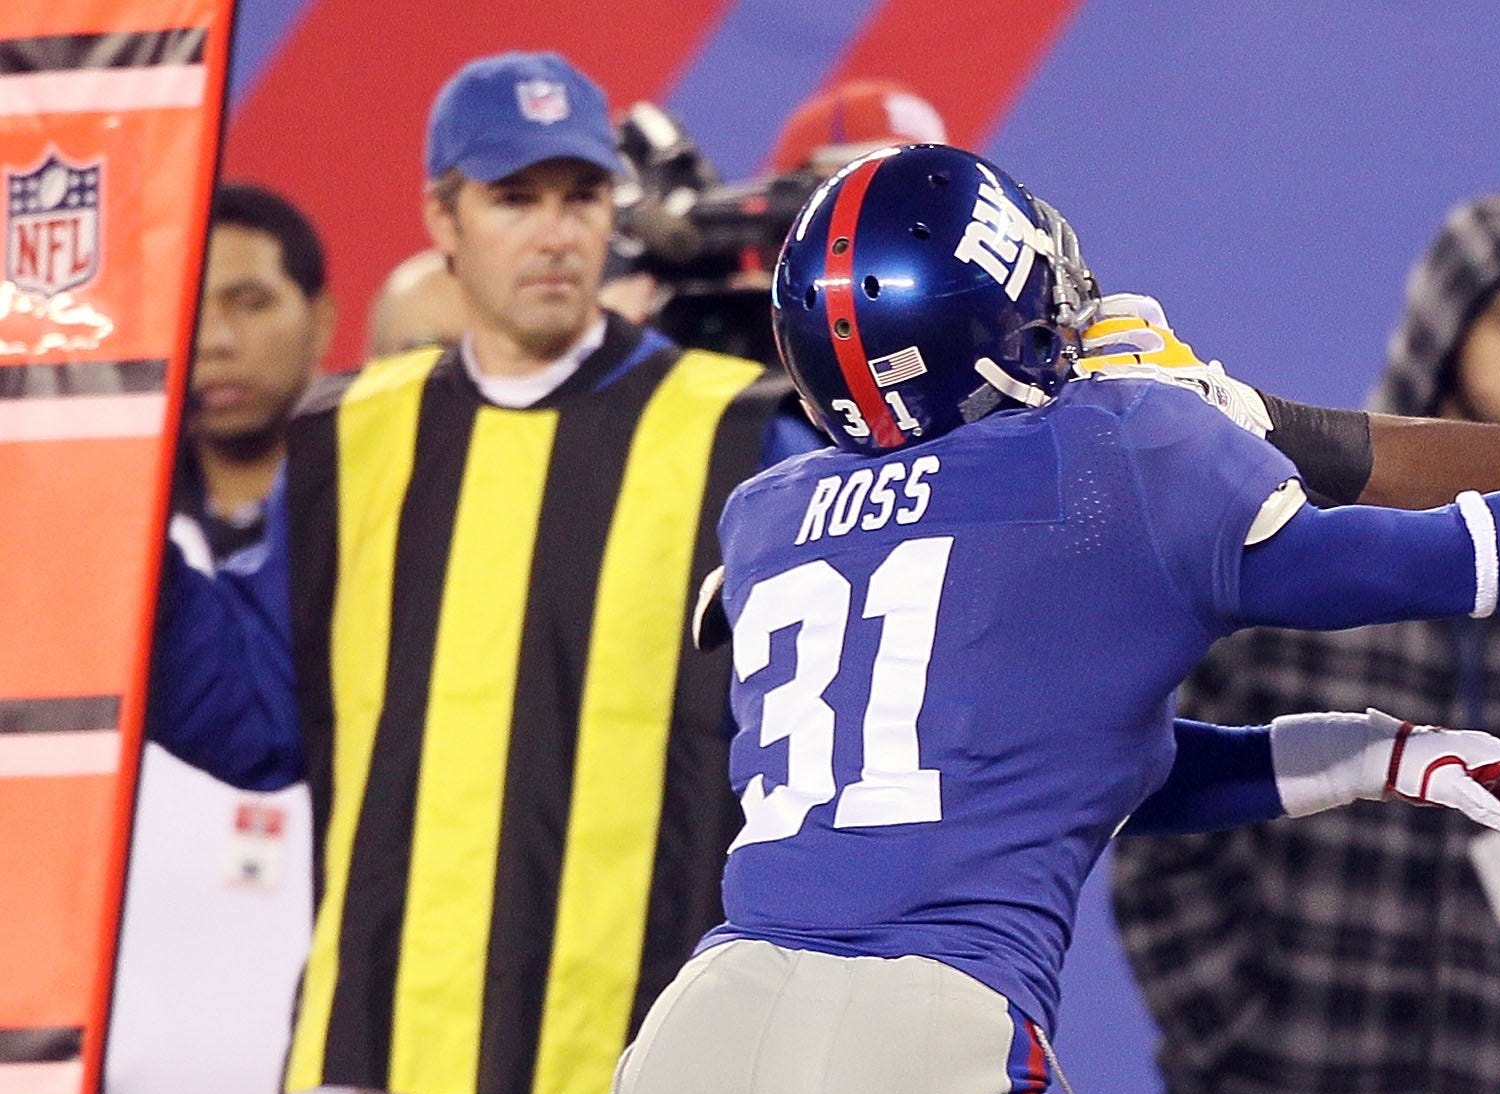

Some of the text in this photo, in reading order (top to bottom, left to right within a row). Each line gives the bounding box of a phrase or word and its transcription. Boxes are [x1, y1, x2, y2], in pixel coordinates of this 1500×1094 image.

[16, 217, 90, 283] NFL
[831, 390, 921, 437] 31
[794, 455, 941, 546] ROSS
[727, 536, 955, 855] 31
